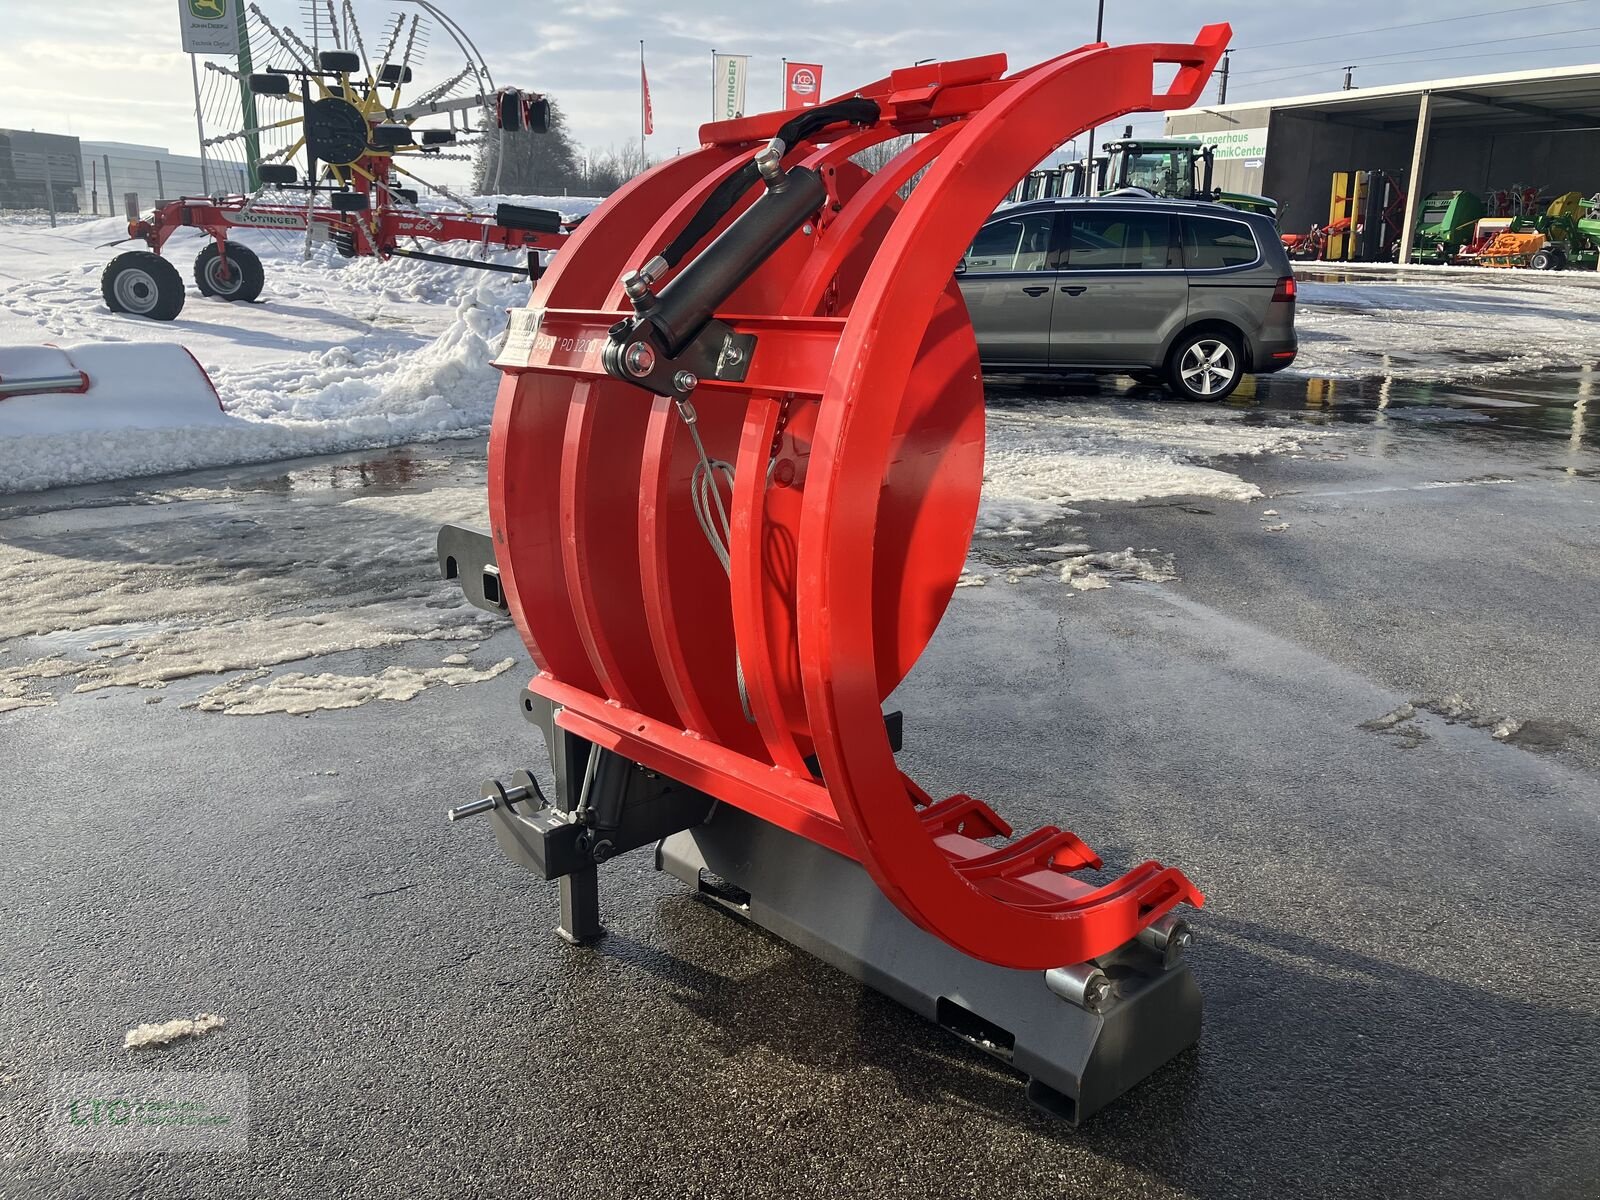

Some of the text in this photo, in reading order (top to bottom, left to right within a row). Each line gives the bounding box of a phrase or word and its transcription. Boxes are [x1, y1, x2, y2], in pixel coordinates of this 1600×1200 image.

[727, 60, 736, 118] OTTINGER
[1201, 132, 1249, 145] Lagerhaus
[1212, 146, 1265, 158] hnikCenter
[535, 336, 555, 350] PAN
[560, 338, 573, 351] PD
[574, 339, 598, 353] 1200
